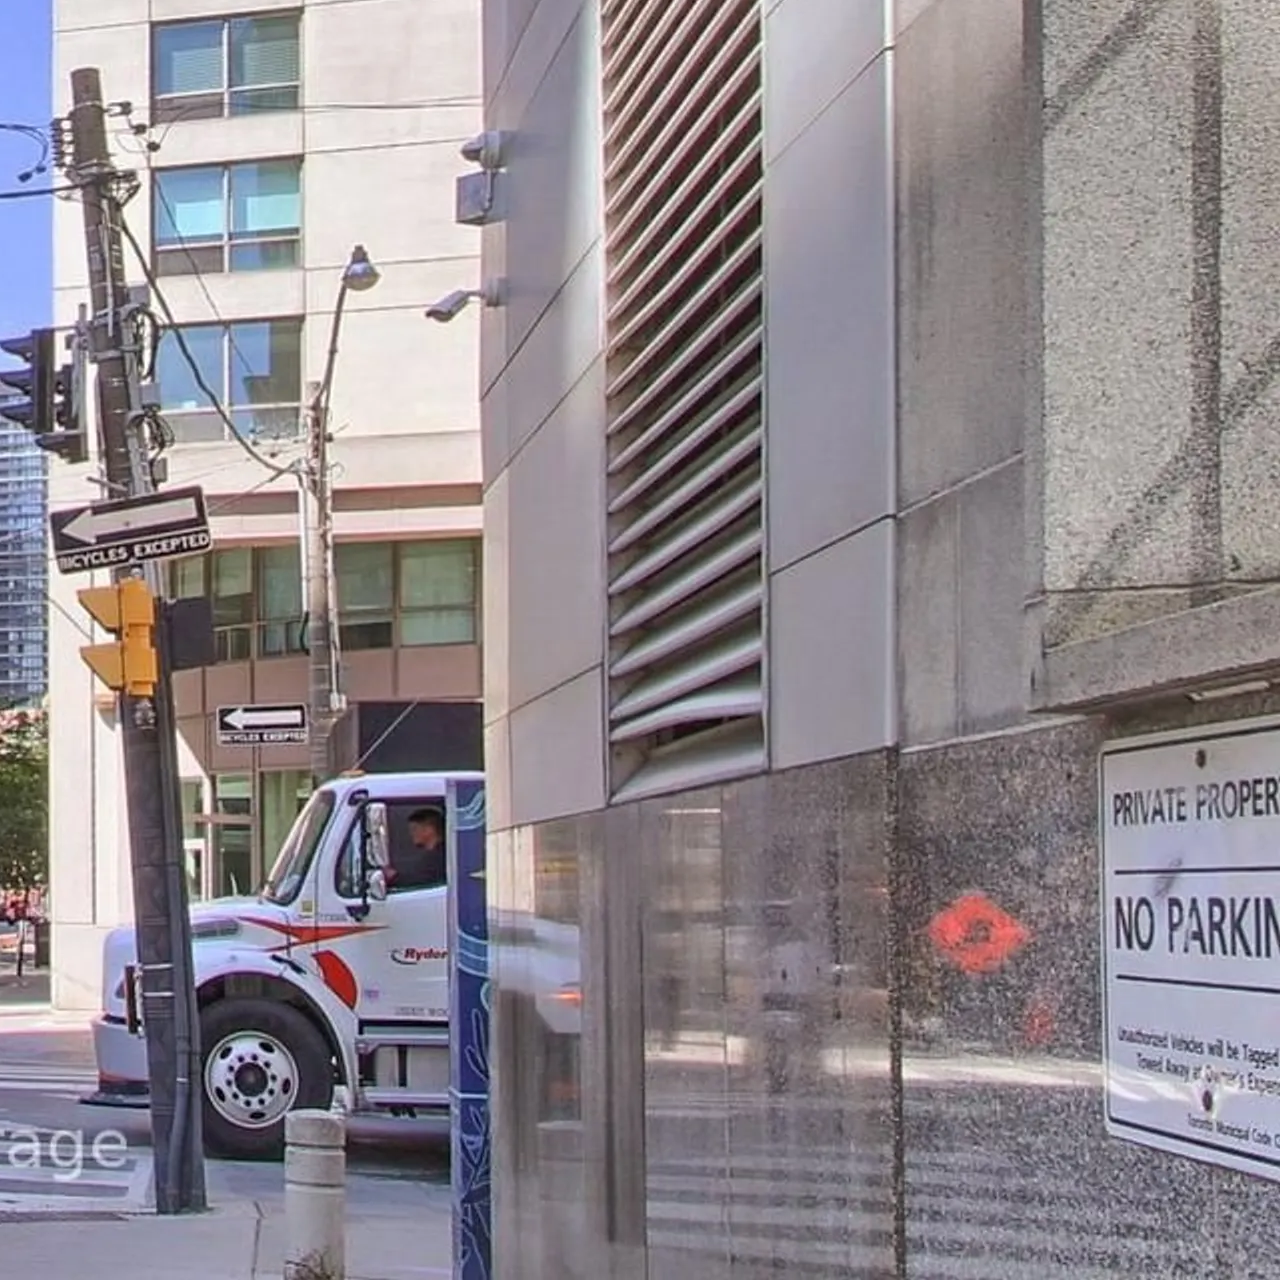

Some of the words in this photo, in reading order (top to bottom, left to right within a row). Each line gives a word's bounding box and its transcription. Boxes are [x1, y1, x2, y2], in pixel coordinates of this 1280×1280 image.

[59, 546, 128, 570] BICYCLES
[134, 532, 211, 558] EXCEPTED
[1113, 787, 1187, 826] PRIVATE
[1196, 776, 1280, 821] PROPER
[1115, 896, 1155, 951] NO
[403, 948, 448, 962] Ryder
[1137, 1052, 1163, 1073] Towed
[1166, 1058, 1189, 1082] Away
[1208, 1038, 1223, 1057] will
[1226, 1040, 1239, 1060] be
[1242, 1044, 1279, 1069] Tagged
[1252, 1128, 1271, 1147] Code
